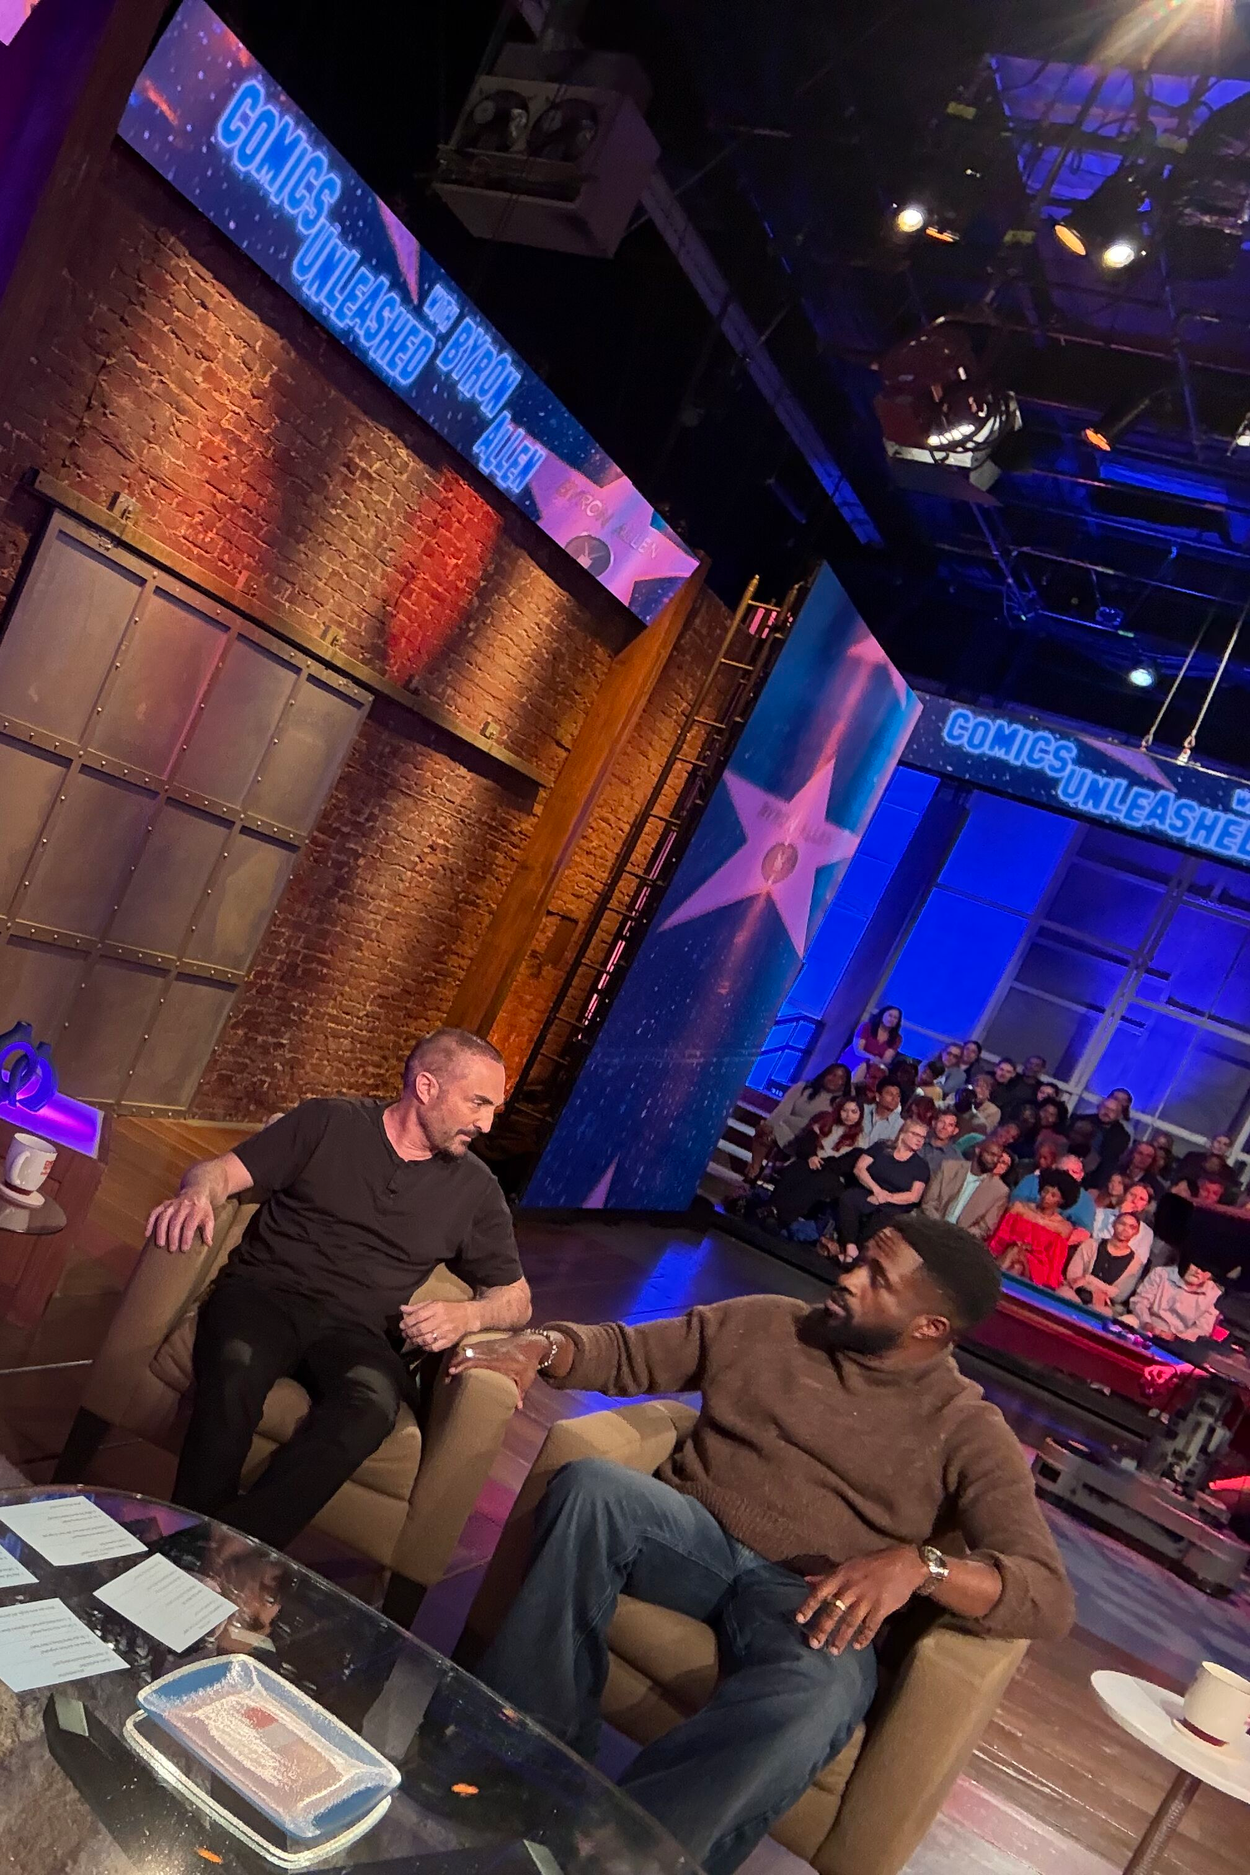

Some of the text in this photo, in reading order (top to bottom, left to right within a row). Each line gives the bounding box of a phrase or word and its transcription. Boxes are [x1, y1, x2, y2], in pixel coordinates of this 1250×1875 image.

[218, 79, 342, 235] COMICS
[293, 219, 435, 385] UNLEASHED
[424, 284, 522, 419] WITH BYRON
[473, 410, 546, 493] ALLEN
[555, 479, 614, 530] BYRON
[944, 709, 1077, 777] COMICS
